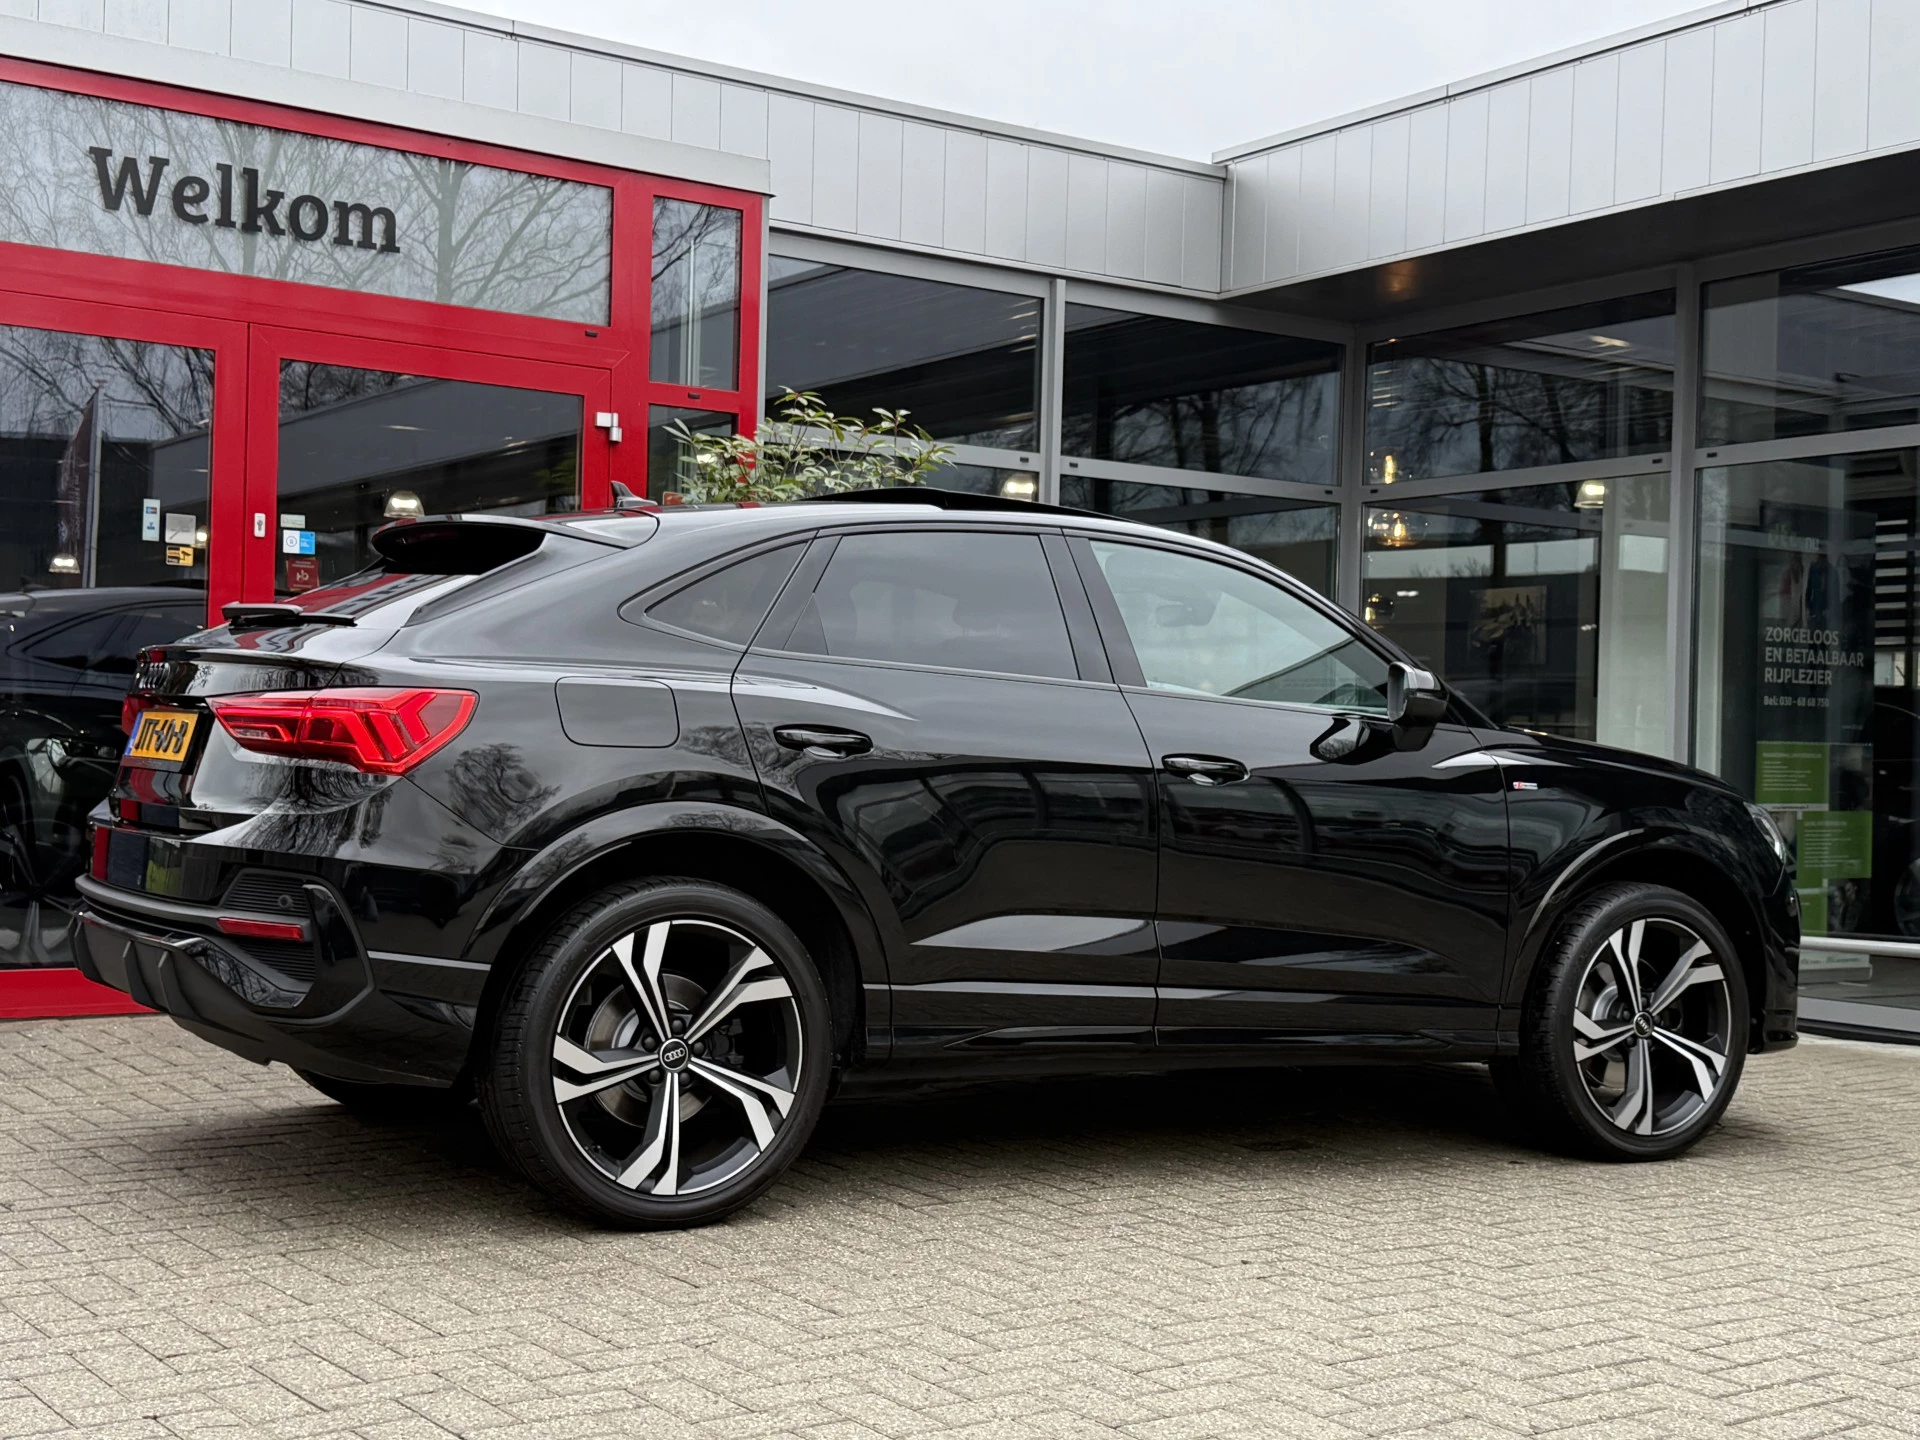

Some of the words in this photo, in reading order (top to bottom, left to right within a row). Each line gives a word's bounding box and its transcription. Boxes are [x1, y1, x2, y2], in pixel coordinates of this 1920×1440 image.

[88, 145, 400, 253] Welkom
[1765, 626, 1839, 645] ZORGELOOS
[1764, 647, 1782, 662] EN
[1786, 648, 1864, 667] BETAALBAAR
[1764, 667, 1832, 685] RIJPLEZIER
